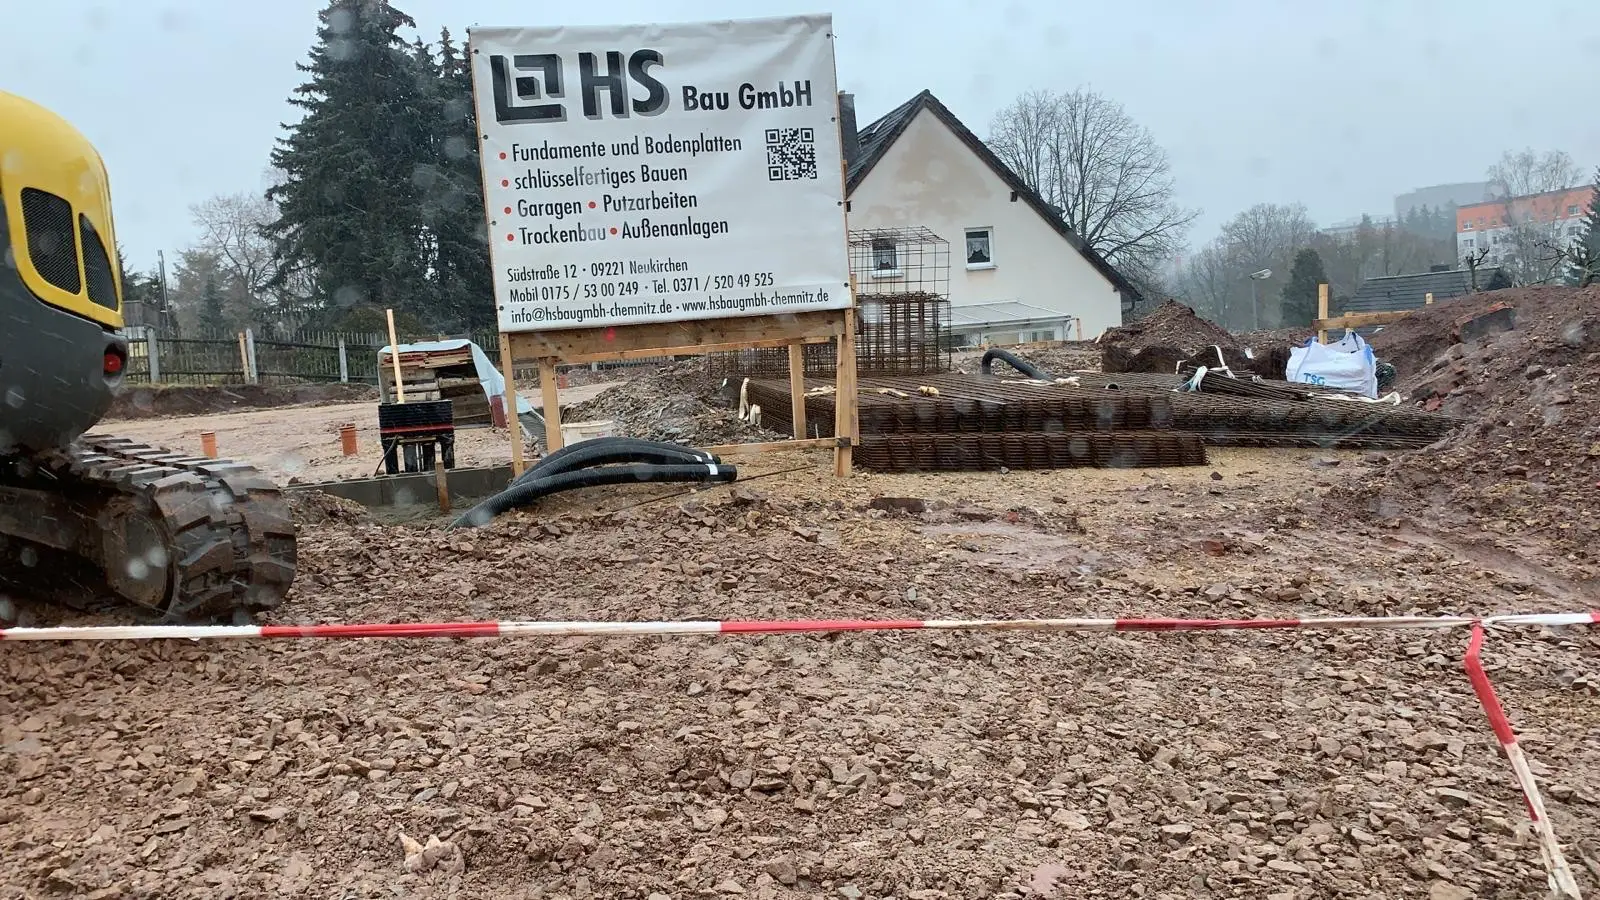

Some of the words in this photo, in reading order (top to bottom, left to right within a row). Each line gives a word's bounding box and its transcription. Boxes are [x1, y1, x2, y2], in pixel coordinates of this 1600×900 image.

[578, 49, 670, 120] HS
[682, 86, 729, 112] Bau
[738, 80, 812, 110] GmbH
[512, 141, 606, 162] Fundamente
[611, 135, 640, 156] und
[646, 132, 742, 156] Bodenplatten
[514, 166, 636, 190] schlüsselfertiges
[641, 166, 688, 182] Bauen
[518, 199, 582, 219] Garagen
[603, 192, 698, 213] Putzarbeiten
[519, 222, 606, 244] Trockenbau
[621, 216, 729, 239] Außenanlagen
[507, 265, 560, 282] Südstraße
[563, 263, 578, 278] 12
[591, 262, 625, 277] 09221
[629, 258, 688, 274] Neukirchen
[510, 288, 538, 303] Mobil
[541, 286, 571, 301] 0175
[584, 283, 598, 298] 53
[600, 283, 615, 297] 00
[618, 281, 638, 296] 249
[652, 278, 670, 294] Tel.
[672, 277, 699, 292] 0371
[714, 274, 734, 289] 520
[737, 273, 751, 288] 49
[754, 272, 773, 286] 525
[511, 301, 672, 323] info@hsbaugmbh-chemnitz.de
[682, 289, 829, 312] www.hsbaugmbh-chemnitz.de
